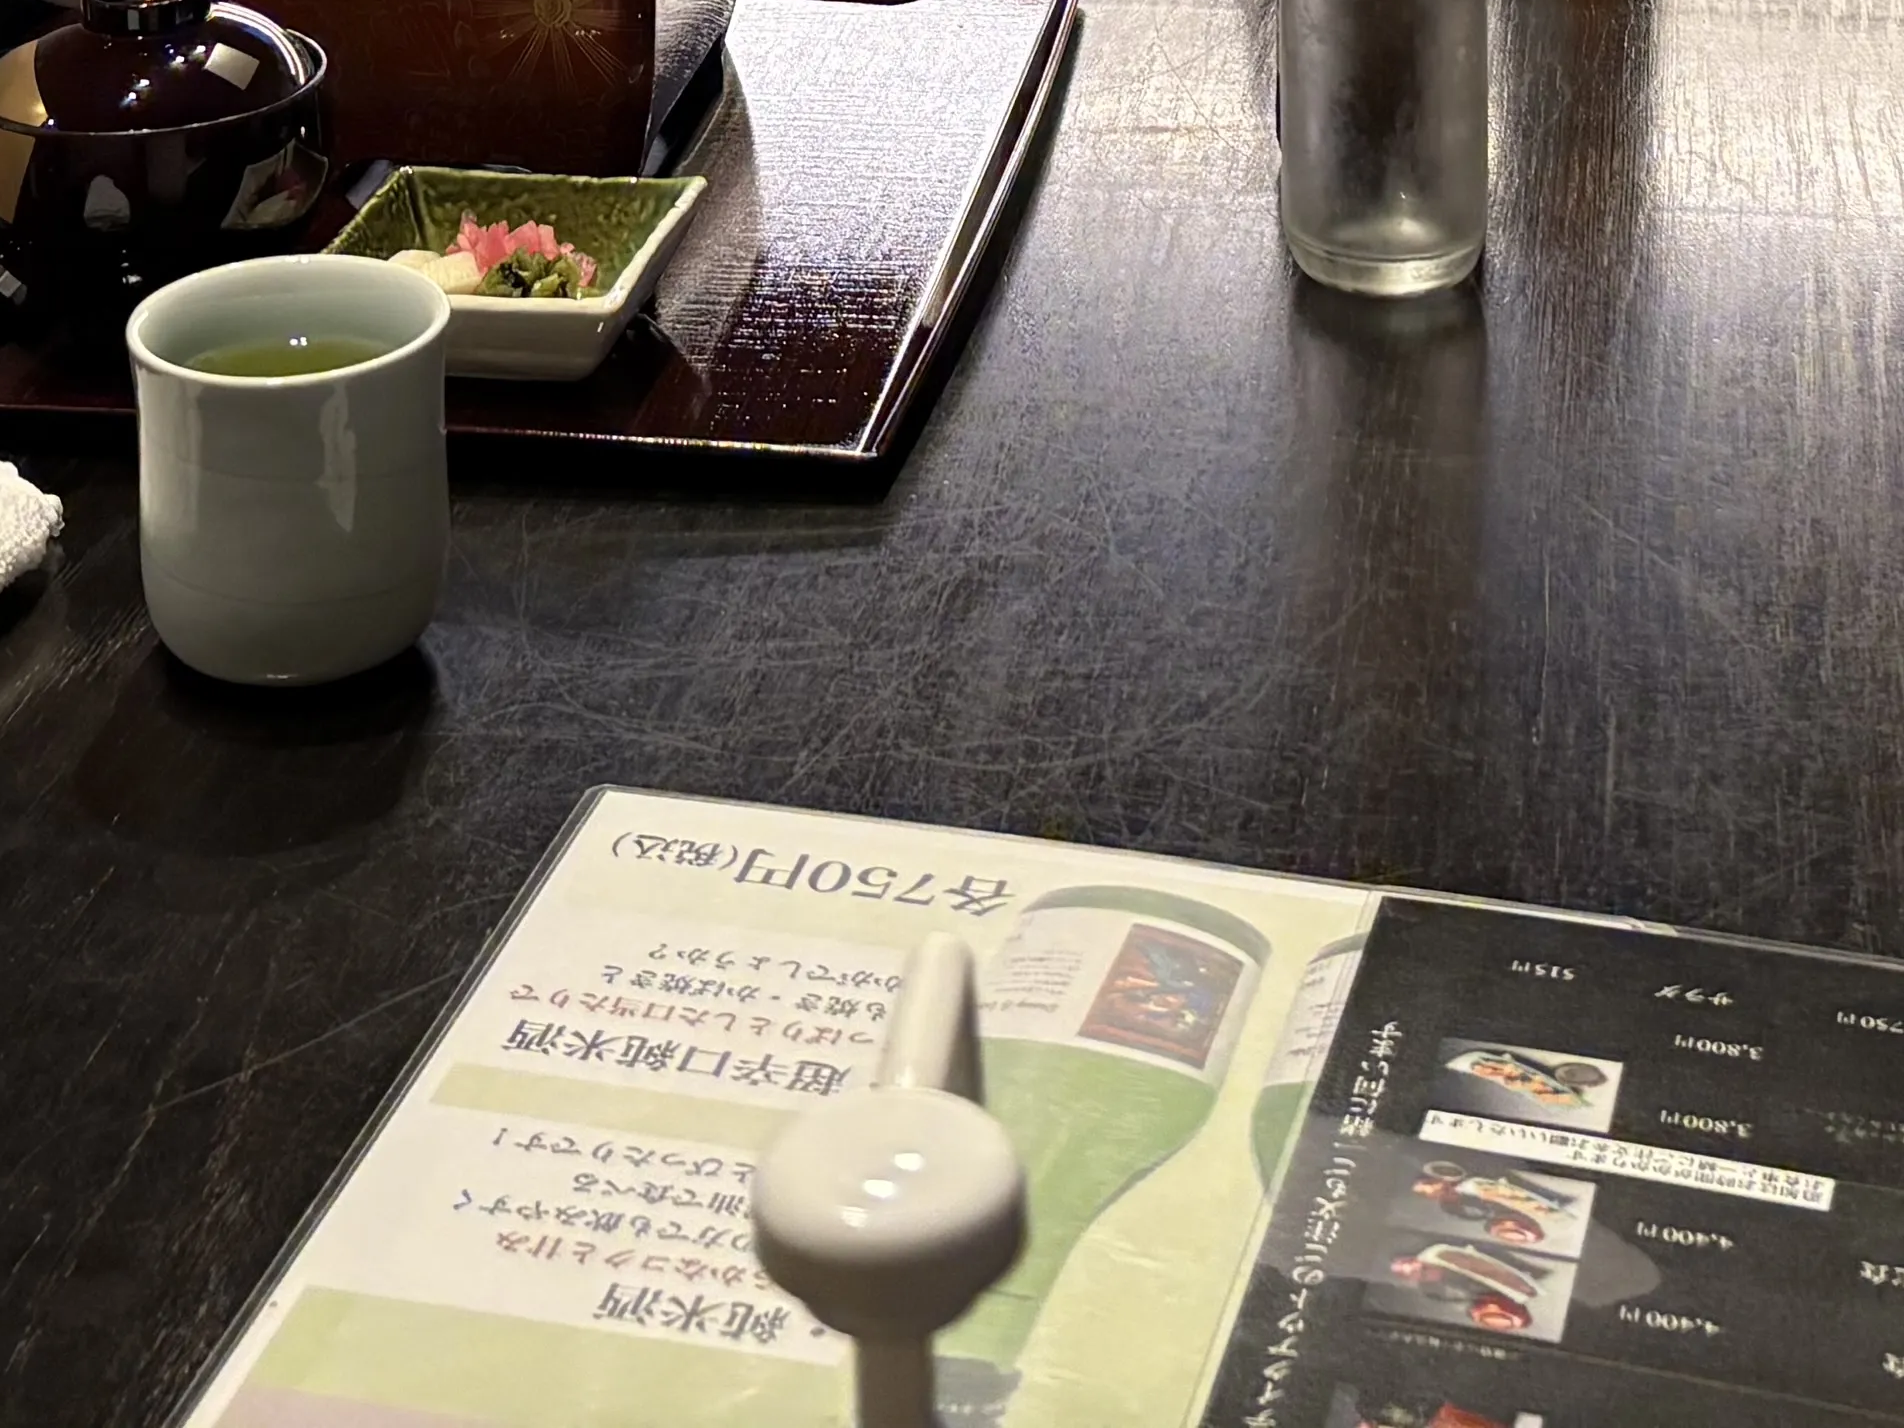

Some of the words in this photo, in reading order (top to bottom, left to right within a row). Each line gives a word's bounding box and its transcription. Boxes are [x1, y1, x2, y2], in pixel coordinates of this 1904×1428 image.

[611, 831, 1015, 917] 各750円(税込)
[1652, 983, 1734, 1008] サラダ
[1836, 1011, 1904, 1034] 750円
[502, 1019, 851, 1097] 超辛口純米酒
[1673, 1033, 1764, 1061] 3,800円
[1659, 1109, 1753, 1139] 3,800円
[572, 1172, 751, 1219] 油で食べる
[1636, 1221, 1734, 1251] 4,400円
[592, 1282, 791, 1344] 純米酒
[1619, 1304, 1718, 1335] 4,400円
